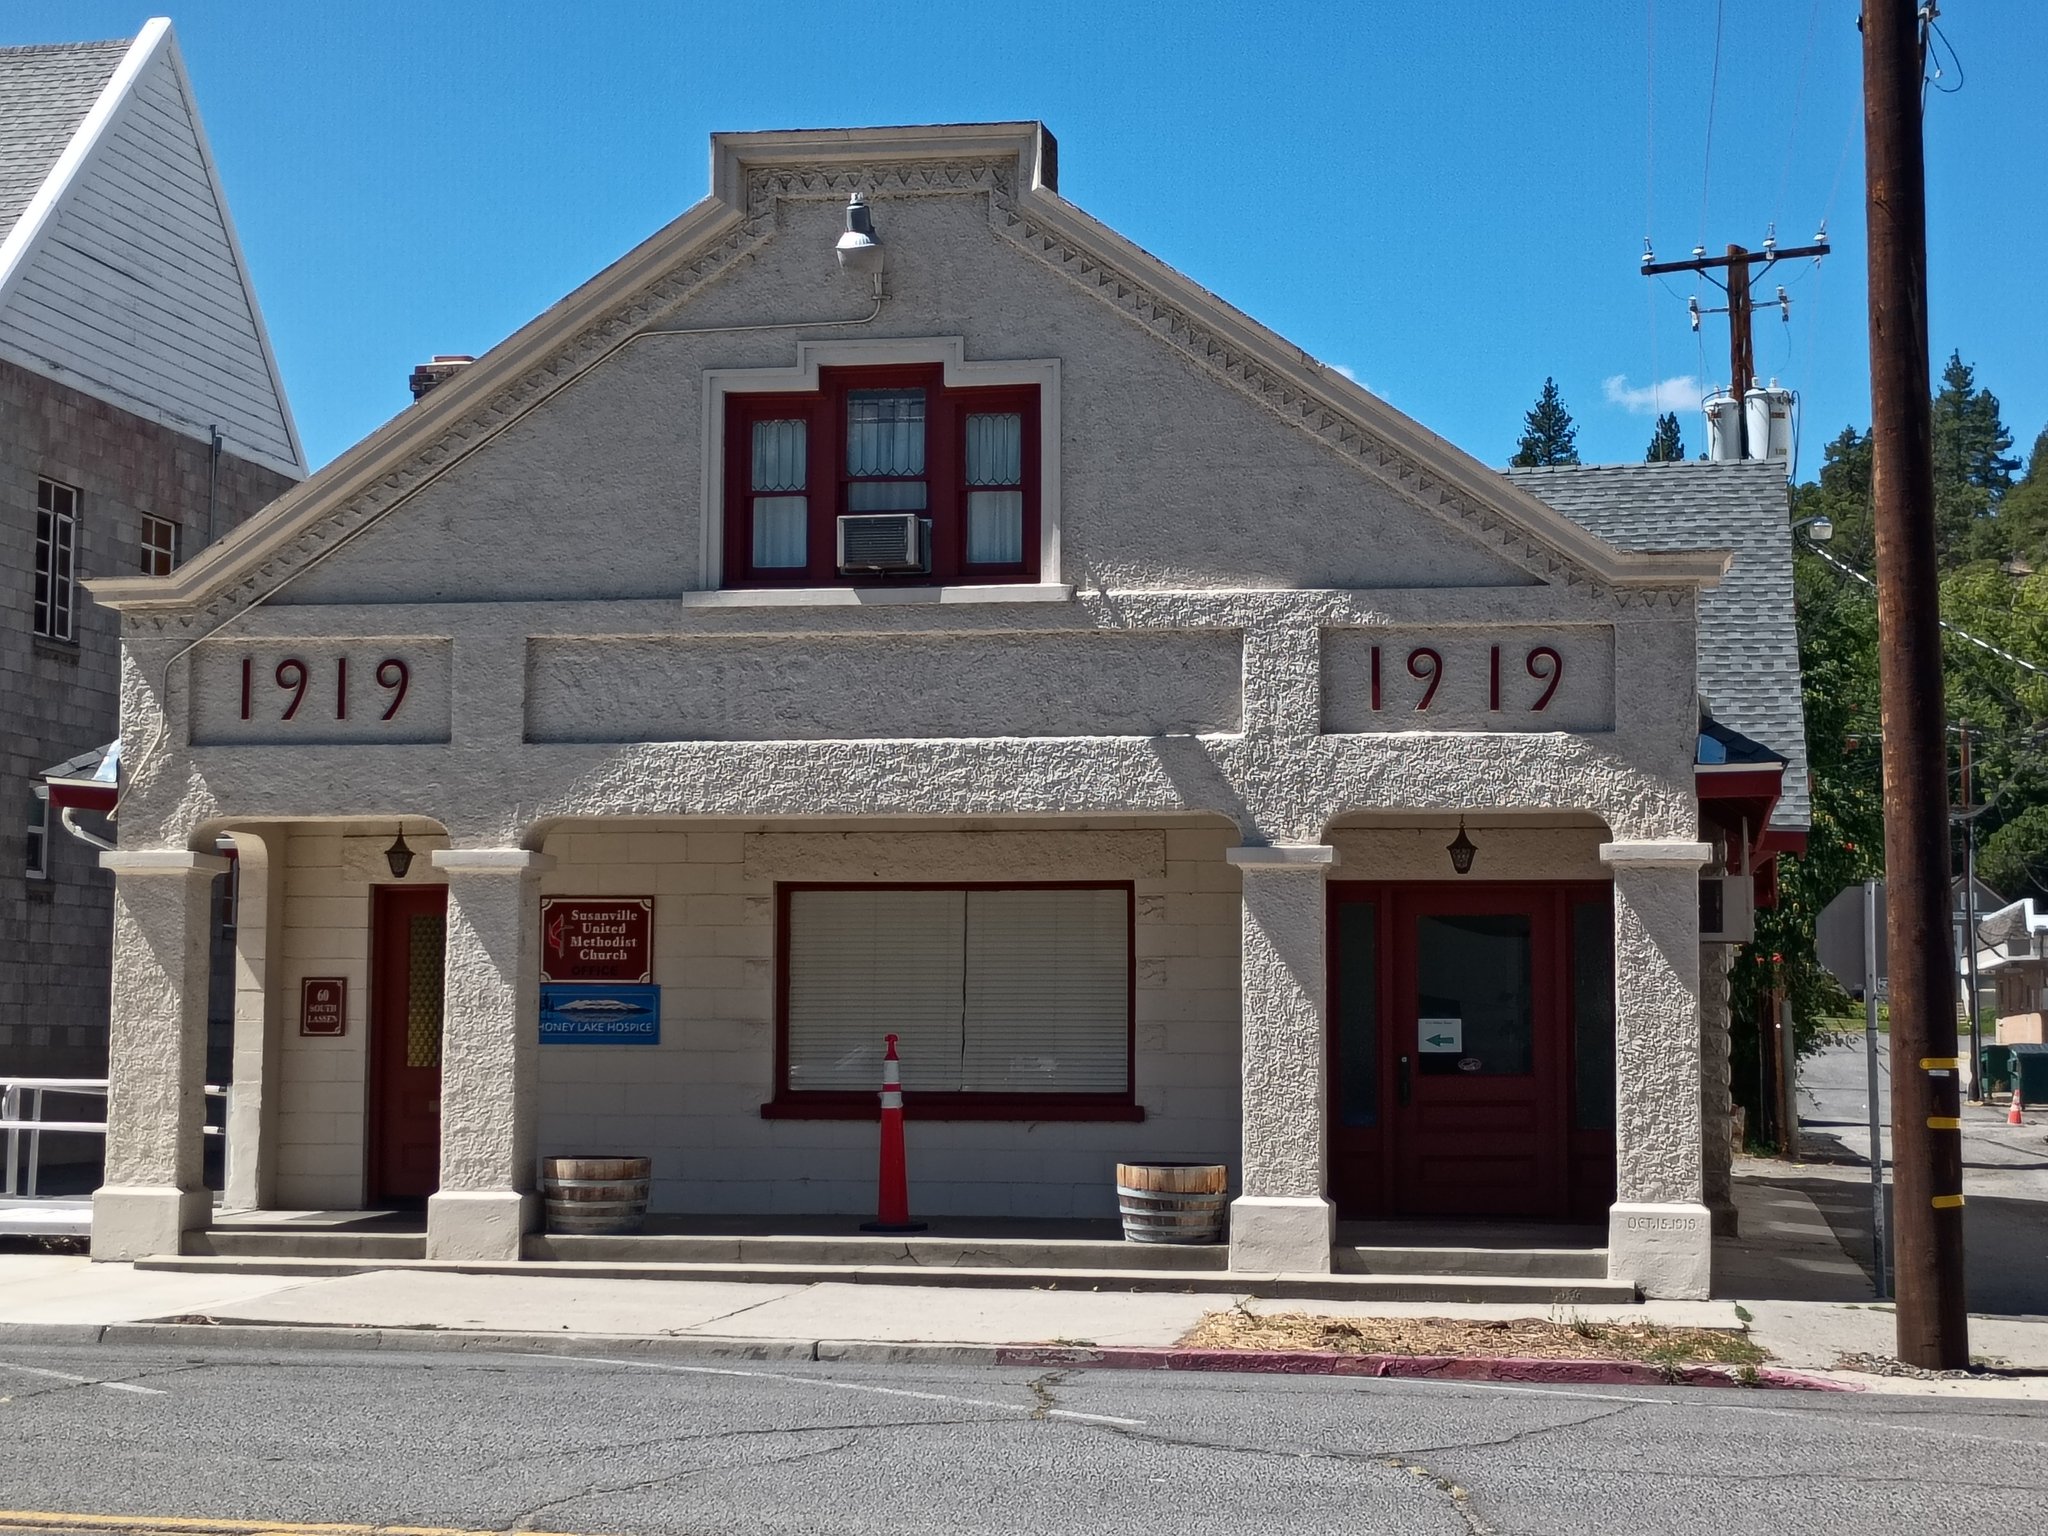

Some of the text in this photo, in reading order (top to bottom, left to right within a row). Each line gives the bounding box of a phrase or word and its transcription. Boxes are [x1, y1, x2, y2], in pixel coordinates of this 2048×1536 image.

[1370, 646, 1563, 712] 1919
[241, 658, 409, 720] 1919
[571, 909, 638, 921] Susanville
[582, 923, 626, 934] United
[570, 936, 638, 947] Methodist
[580, 949, 628, 960] Church
[571, 965, 618, 976] OFFICE
[317, 989, 330, 1002] 60
[309, 1004, 337, 1012] SOUTH
[577, 1022, 605, 1032] LAKE
[607, 1022, 652, 1032] HOSPICE
